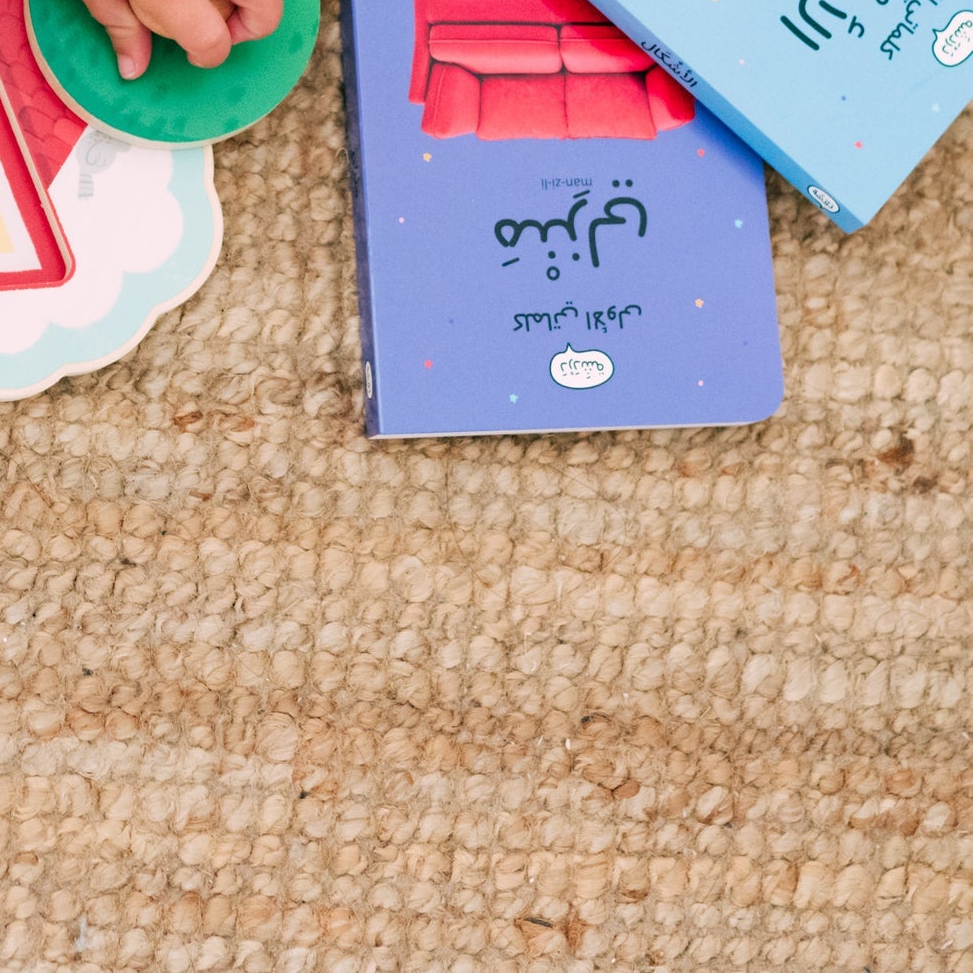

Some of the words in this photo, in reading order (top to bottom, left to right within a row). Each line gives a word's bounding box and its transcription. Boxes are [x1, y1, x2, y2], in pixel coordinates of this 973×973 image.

[541, 178, 593, 190] man-zi-li
[513, 301, 578, 332] كلماتي
[586, 304, 642, 333] الأولى
